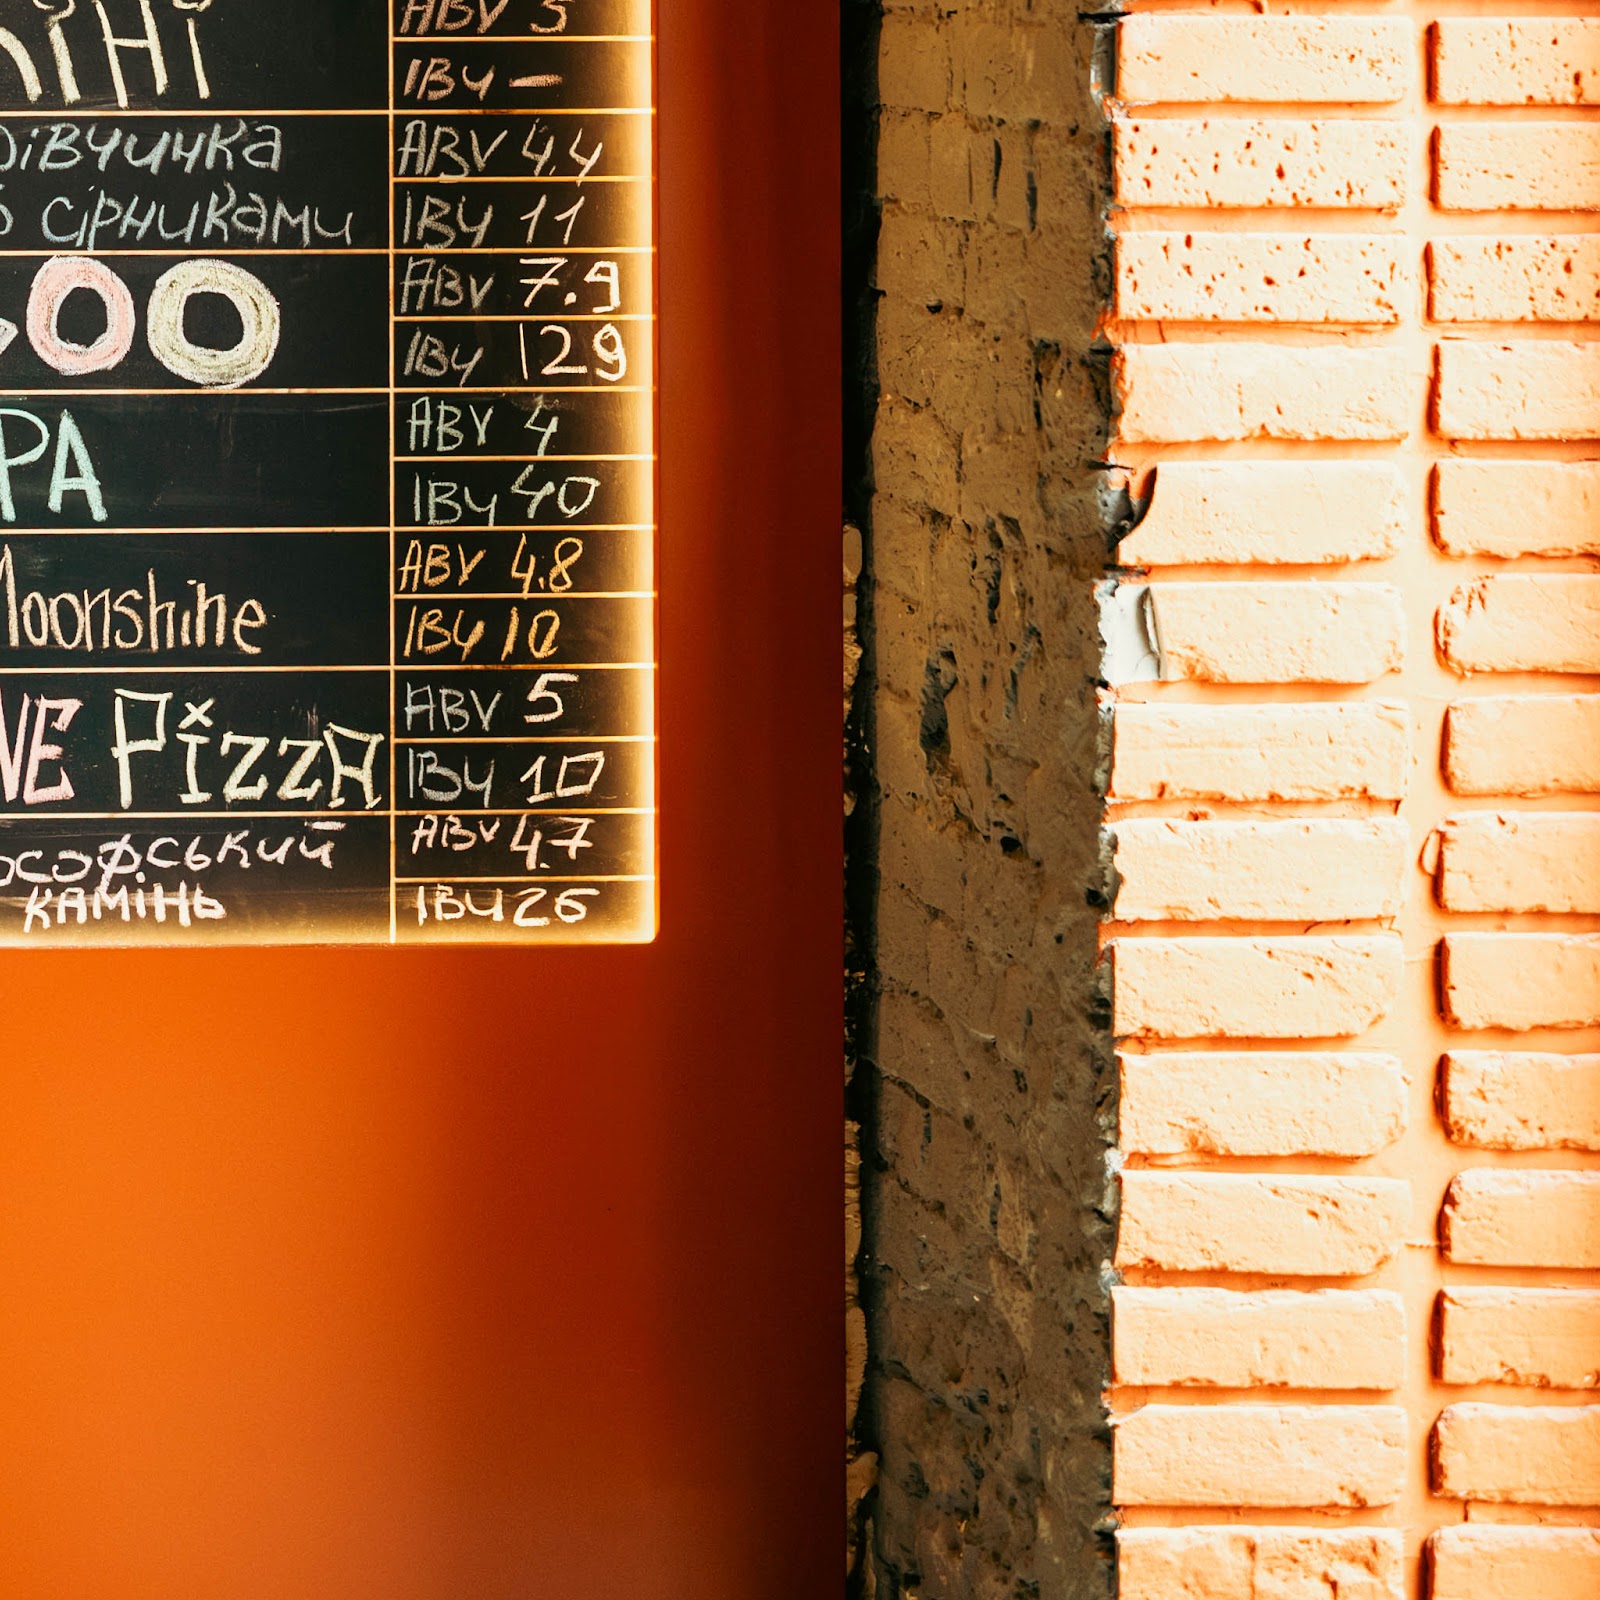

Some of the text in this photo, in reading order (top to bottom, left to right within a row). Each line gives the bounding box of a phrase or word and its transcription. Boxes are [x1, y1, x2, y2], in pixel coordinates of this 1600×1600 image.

[399, 119, 603, 185] ABV 4.4
[520, 195, 585, 245] 11
[399, 257, 619, 313] ABV 7.9
[520, 323, 627, 382] 129
[406, 396, 558, 457] ABV 4
[511, 465, 601, 518] 40
[399, 533, 583, 594] ABV 4.8
[501, 607, 560, 661] 10
[405, 673, 579, 731] ABV 5
[520, 750, 605, 803] 10
[412, 814, 595, 869] ABV 4.7
